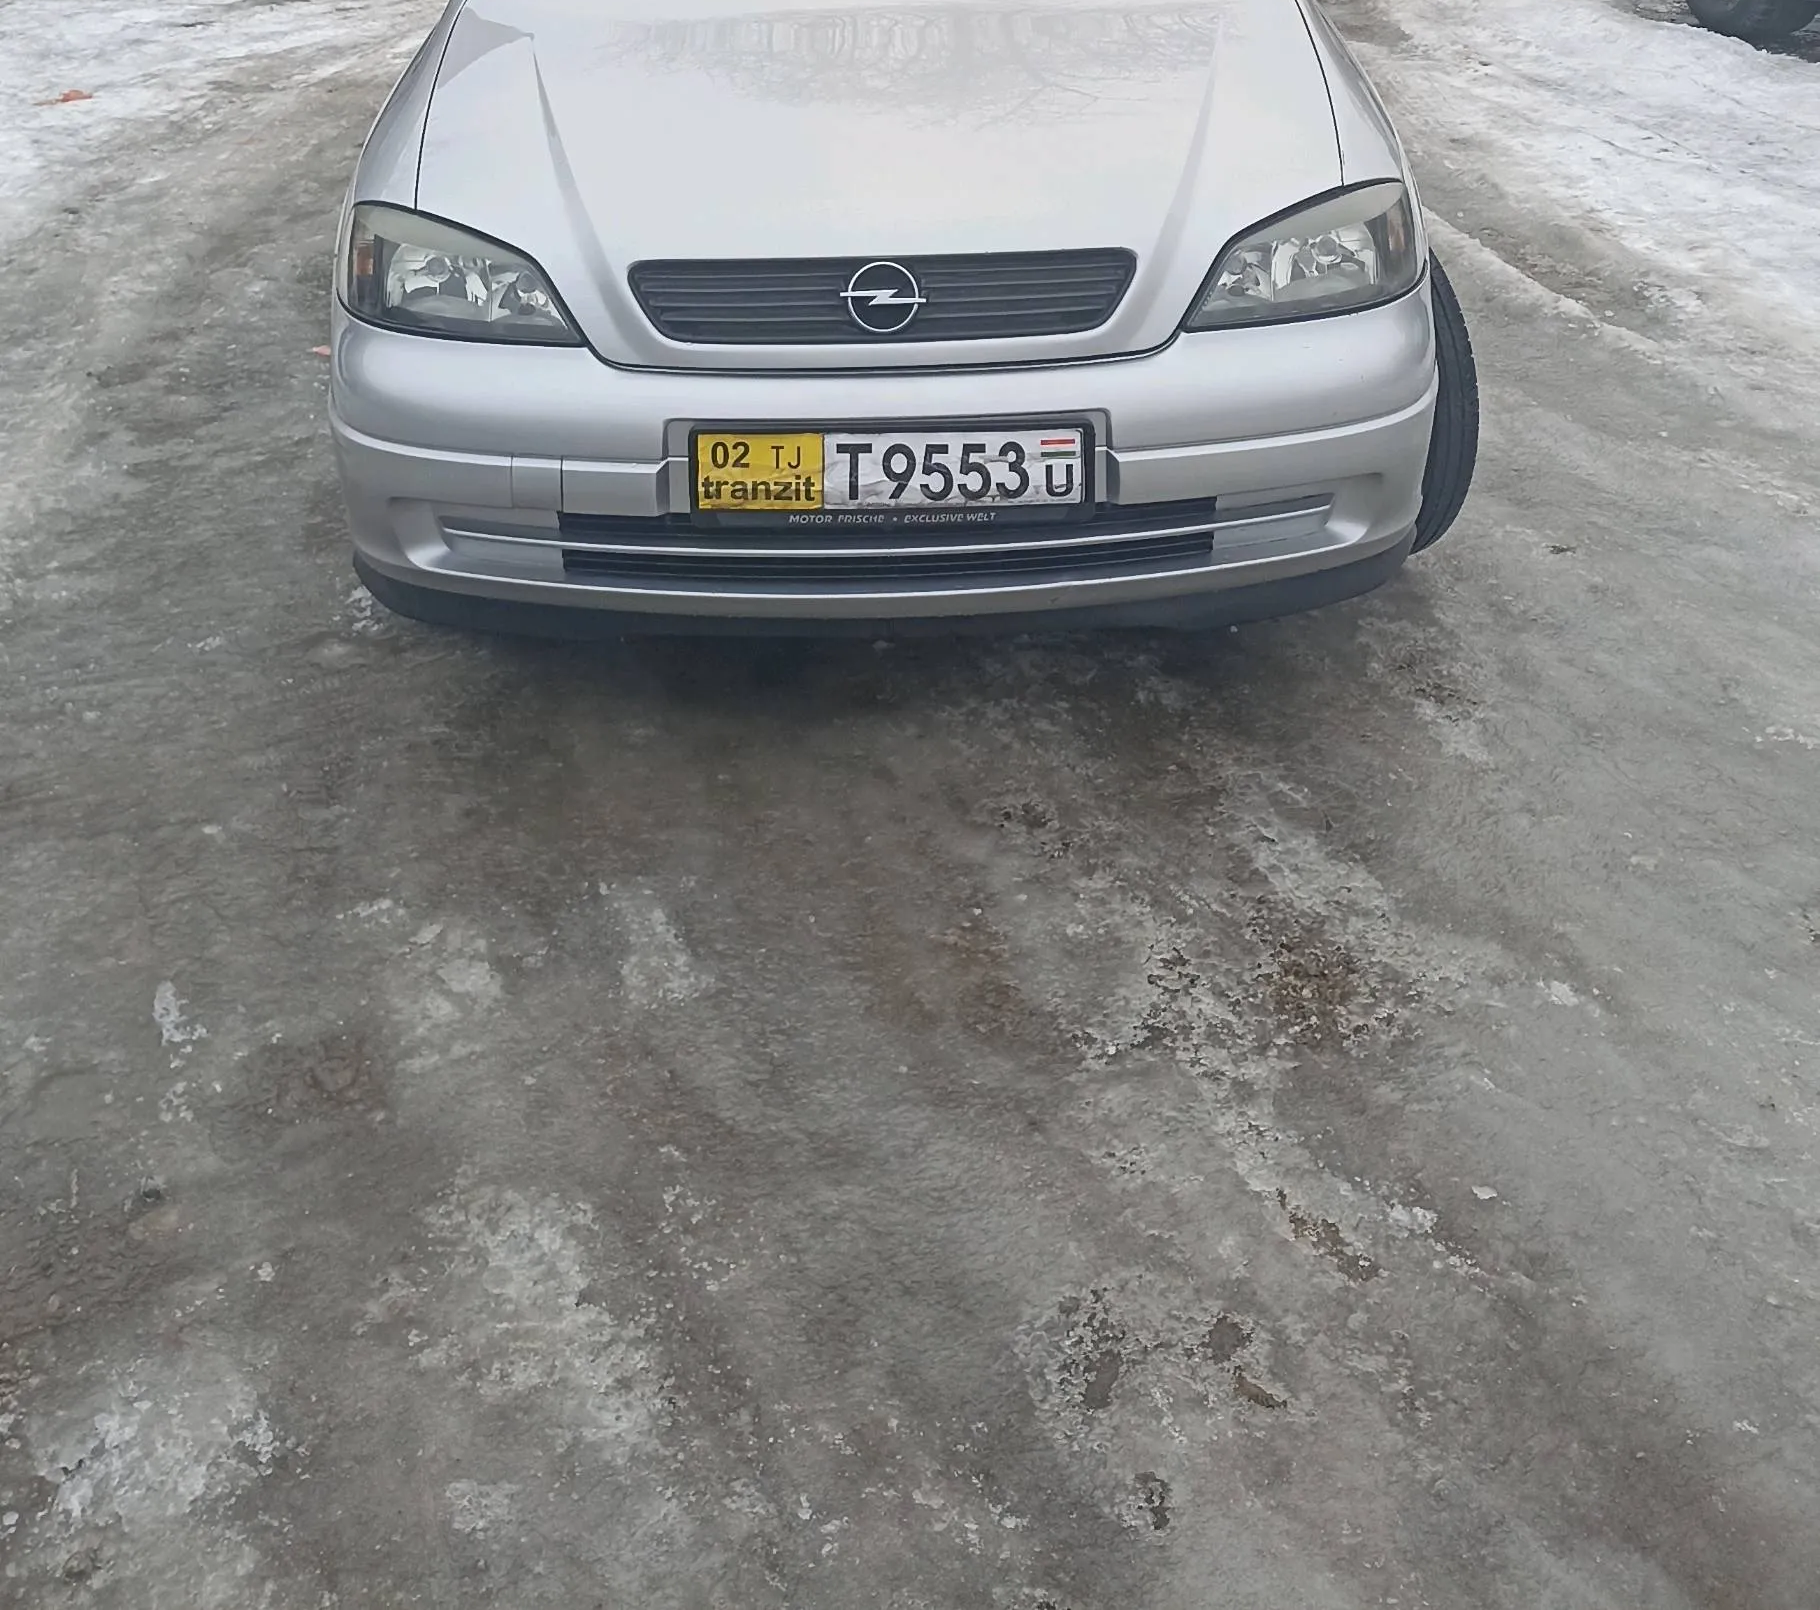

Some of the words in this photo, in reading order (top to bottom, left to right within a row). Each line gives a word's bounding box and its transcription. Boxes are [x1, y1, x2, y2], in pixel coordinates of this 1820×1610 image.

[711, 441, 750, 469] 02
[770, 444, 801, 469] TJ
[836, 440, 1030, 501] T9553
[1046, 463, 1074, 497] U
[701, 474, 815, 502] tranzit
[788, 514, 833, 524] MOTOR
[904, 512, 964, 524] EXCLUSIVE
[966, 511, 996, 522] WELT
